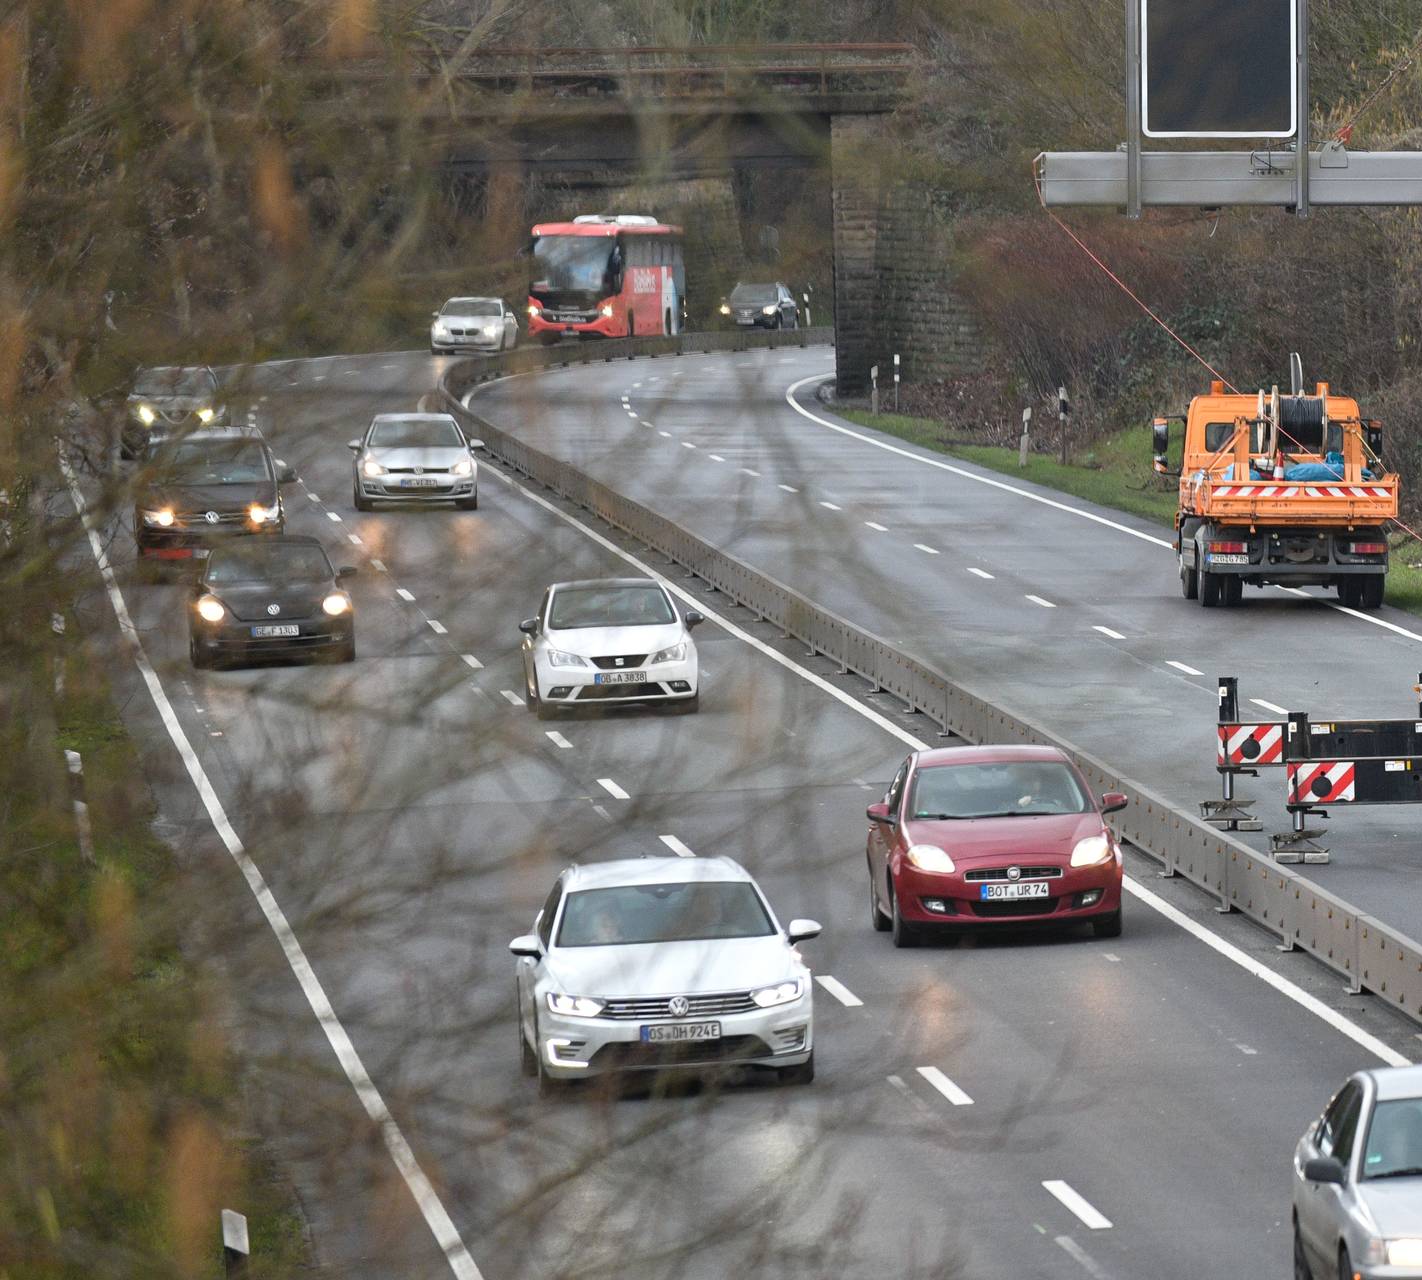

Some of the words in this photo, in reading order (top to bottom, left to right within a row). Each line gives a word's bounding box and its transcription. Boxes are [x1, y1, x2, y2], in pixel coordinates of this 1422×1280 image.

[988, 886, 1009, 897] BOT
[1017, 884, 1031, 896] UR
[1033, 884, 1047, 895] 74
[649, 1027, 664, 1040] OS
[690, 1024, 718, 1037] 924E
